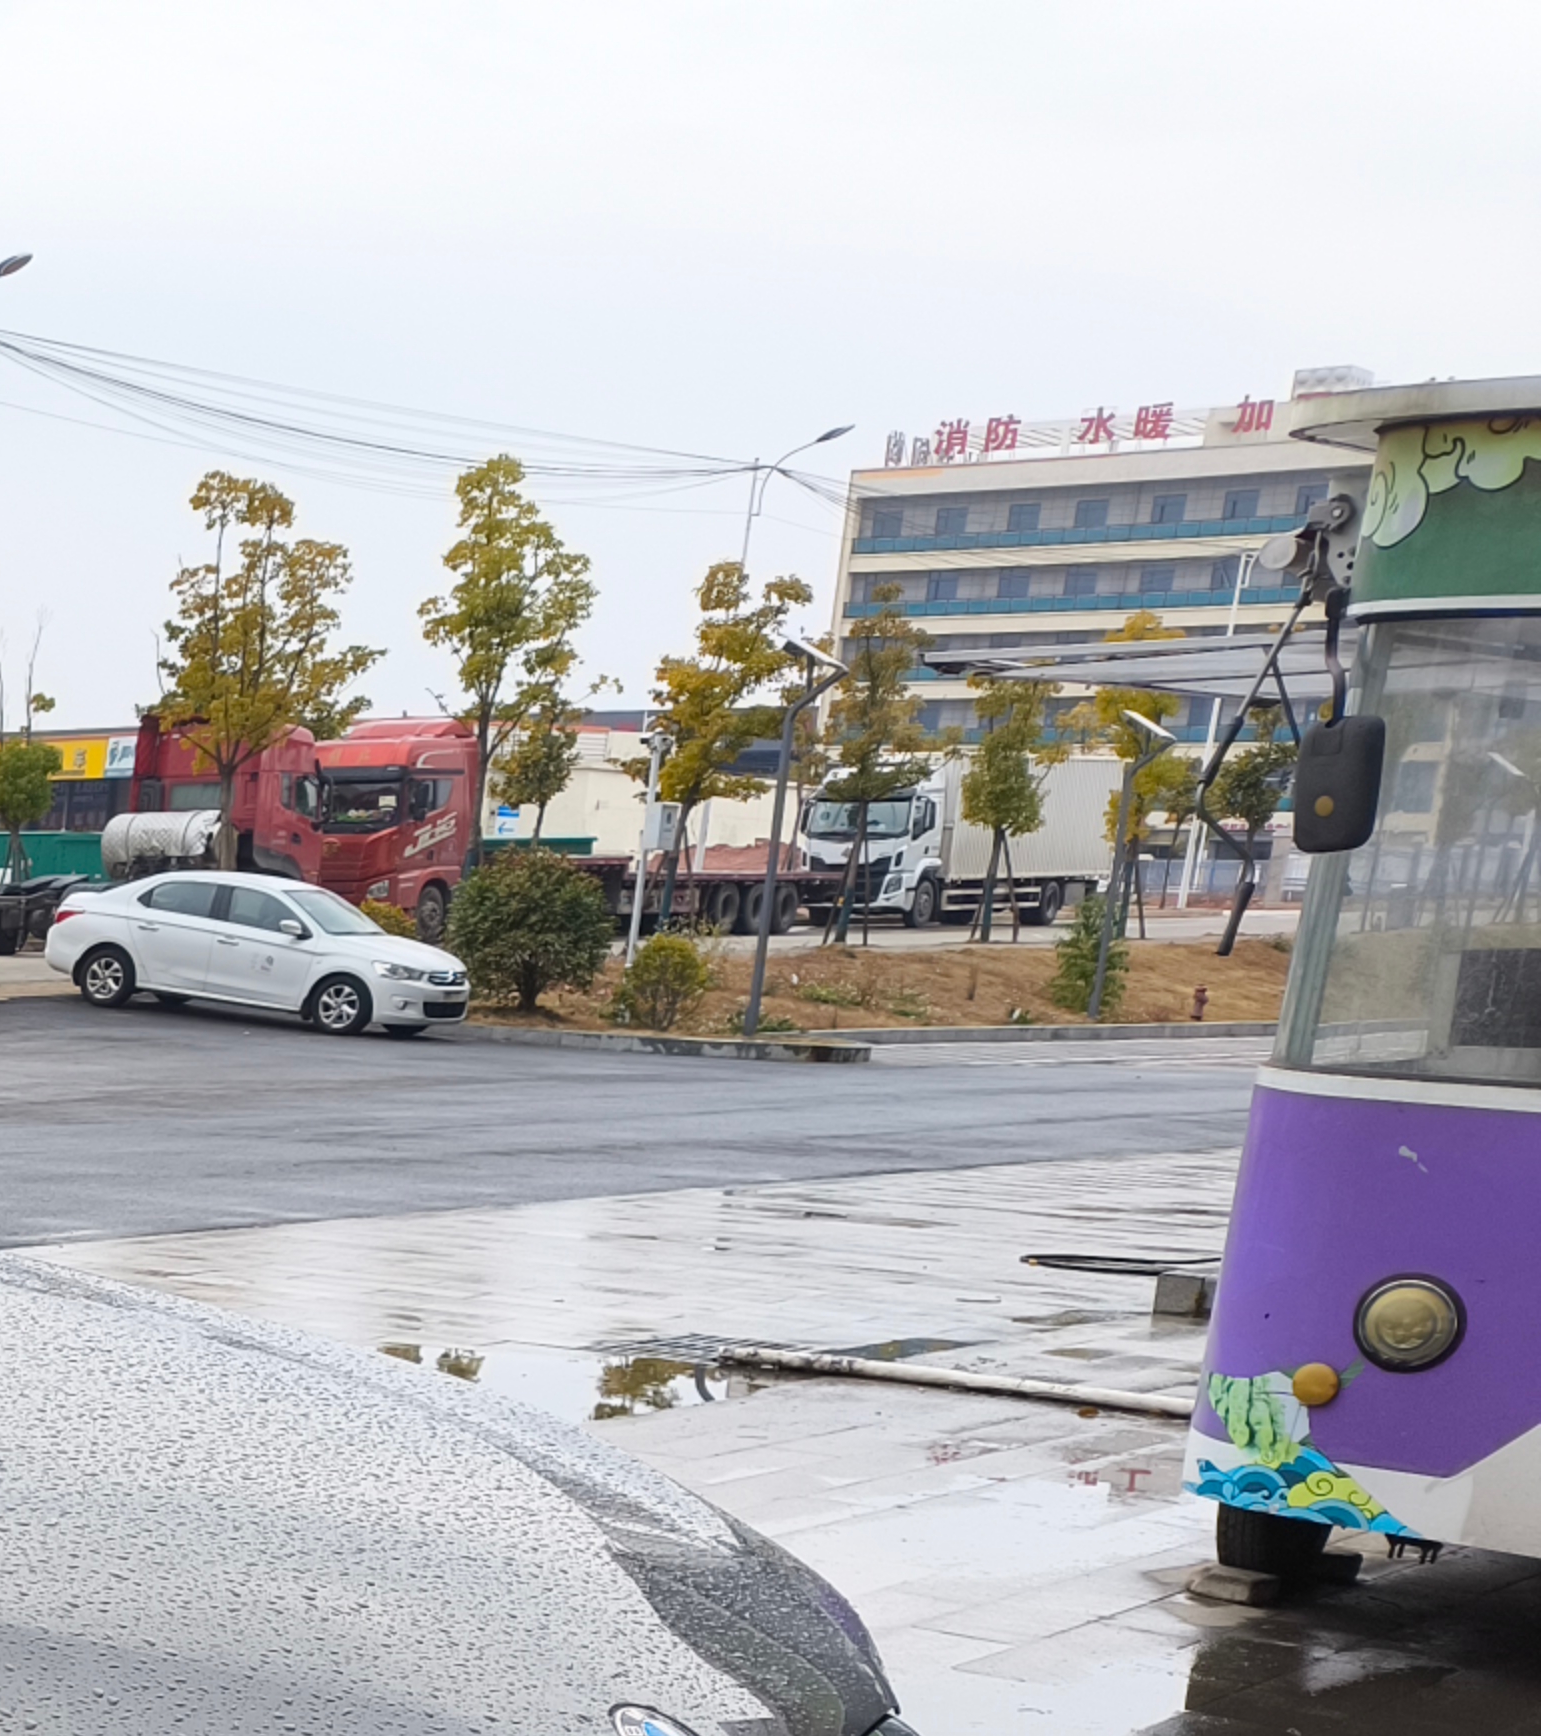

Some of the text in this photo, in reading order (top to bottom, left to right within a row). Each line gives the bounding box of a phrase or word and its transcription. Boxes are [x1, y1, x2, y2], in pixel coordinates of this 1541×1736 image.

[934, 414, 1022, 455] 消防
[1077, 402, 1174, 444] 水暖
[1231, 394, 1275, 432] 加
